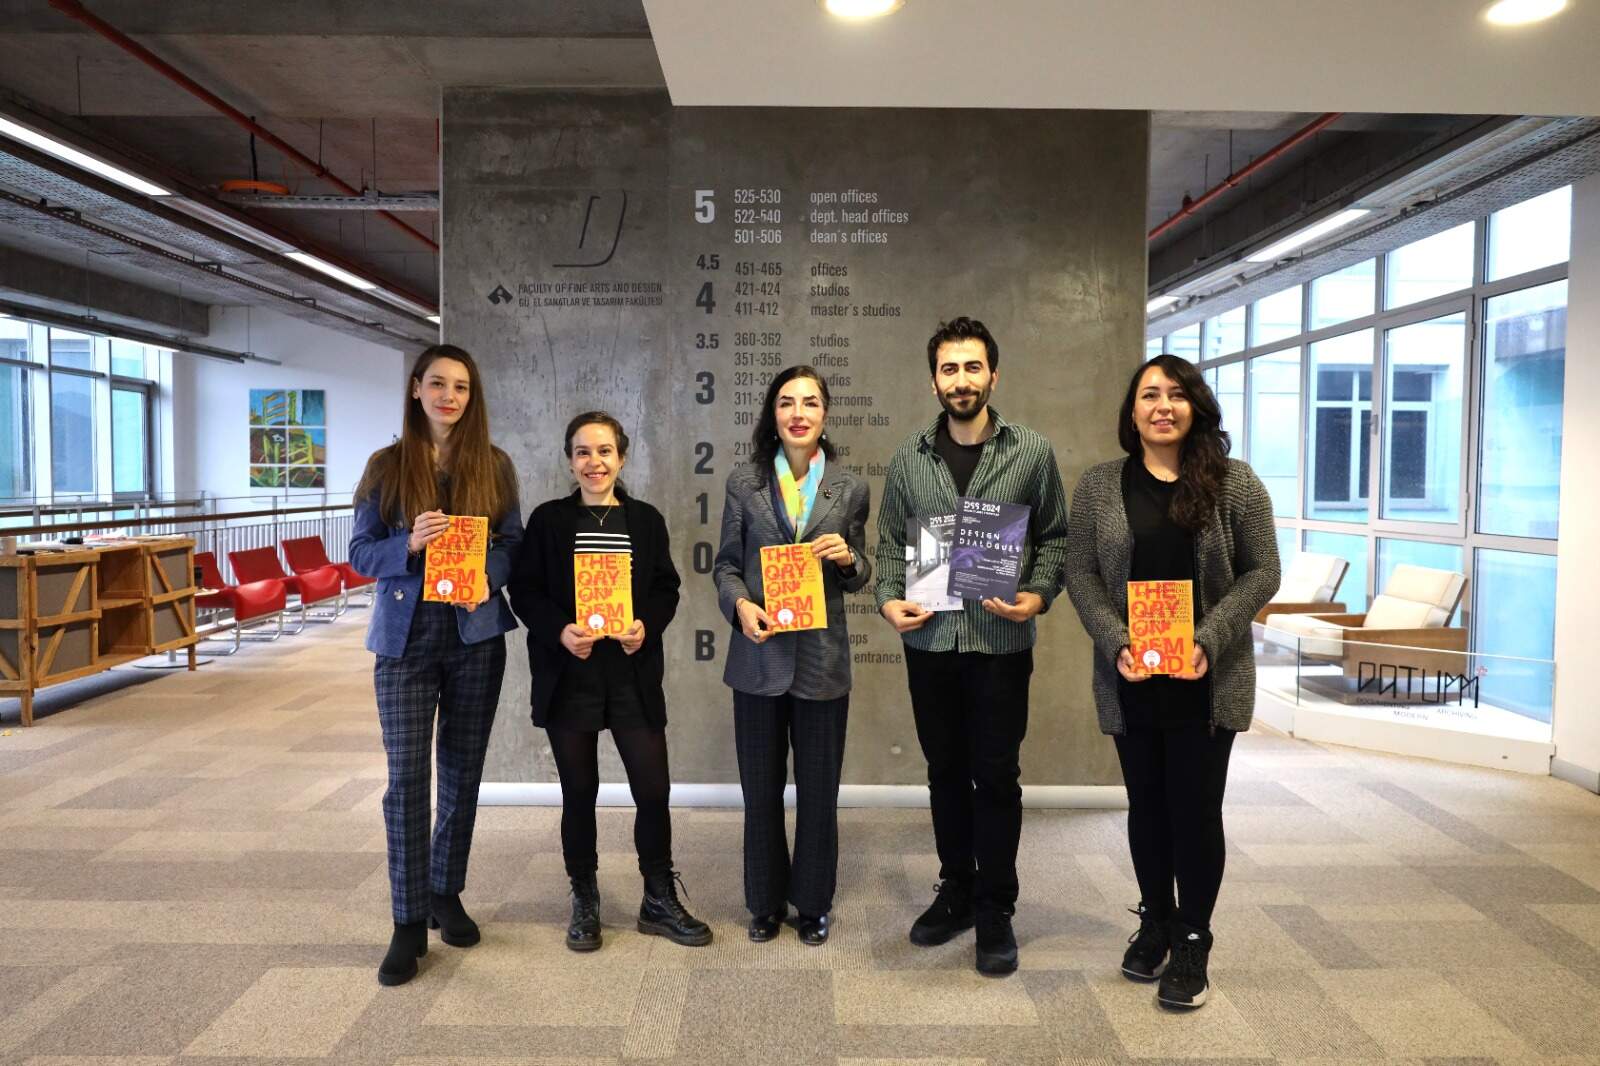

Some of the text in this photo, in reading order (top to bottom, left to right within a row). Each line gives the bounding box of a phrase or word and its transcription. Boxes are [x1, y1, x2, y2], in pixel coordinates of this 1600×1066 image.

[734, 189, 878, 206] 525-530 open offices
[694, 190, 716, 224] 5
[734, 209, 910, 225] 522-540 dept. head offices
[734, 229, 782, 244] 501-506
[850, 229, 888, 244] offices
[696, 254, 720, 270] 4.5
[734, 262, 848, 277] 451-465 offices
[518, 282, 662, 294] FACULTY OF FINE ARTS AND DESIGN
[734, 282, 850, 297] 421-424 studios
[695, 282, 716, 314] 4
[734, 302, 779, 316] 411-412
[862, 302, 902, 317] studios
[696, 333, 720, 350] 3.5
[734, 332, 850, 348] 360-362 studios
[734, 352, 849, 367] 351-356 offices
[695, 372, 716, 405] 3
[828, 396, 873, 407] ssrooms
[867, 412, 890, 426] labs
[694, 442, 714, 475] 2
[695, 492, 708, 525] 1
[982, 503, 1001, 513] 2024
[448, 517, 473, 533] HE
[428, 534, 476, 550] ORY
[960, 529, 1000, 540] DESIGN
[959, 538, 1020, 553] DIALOGUES
[576, 555, 618, 569] THE
[693, 542, 713, 575] 0
[763, 546, 804, 563] THE
[578, 571, 620, 586] ORY
[765, 561, 808, 580] ORY
[1131, 582, 1177, 600] THE
[1132, 601, 1180, 618] ORY
[695, 630, 715, 661] B
[854, 652, 902, 664] entrance
